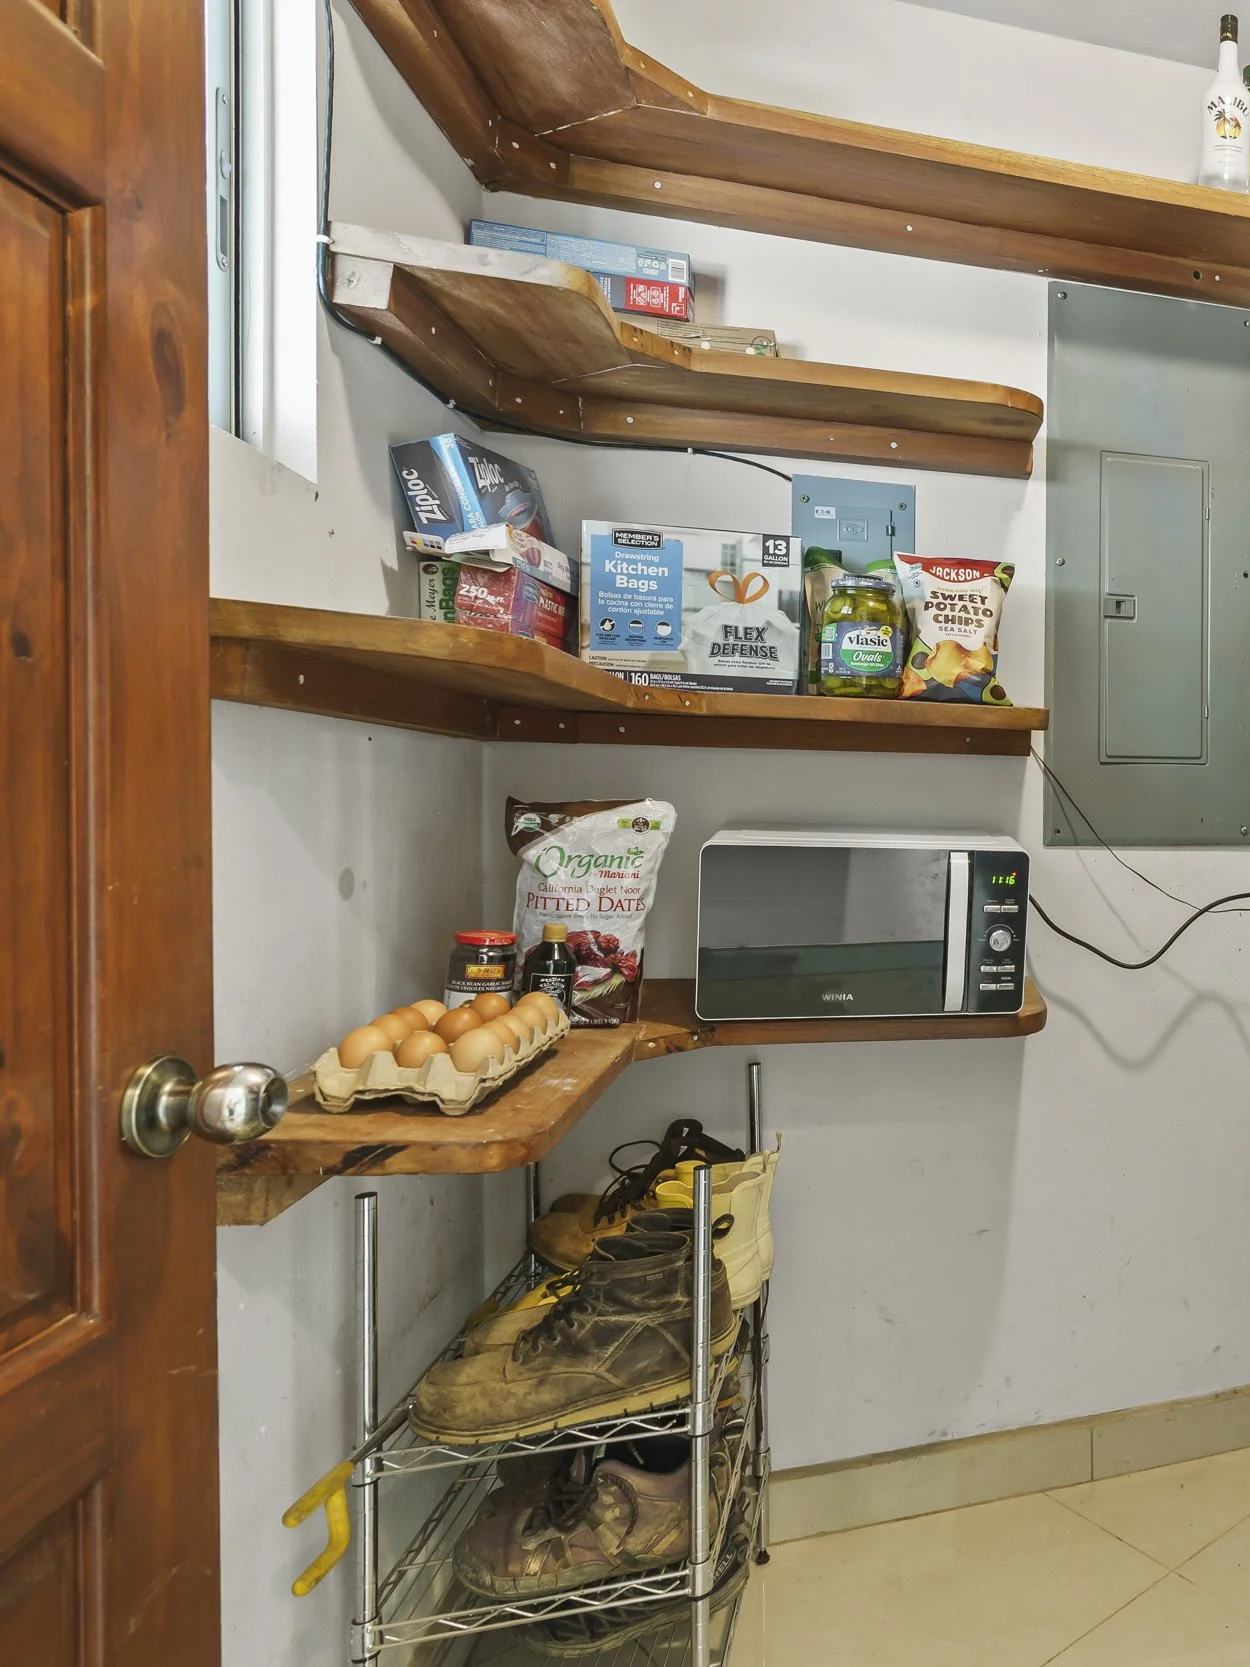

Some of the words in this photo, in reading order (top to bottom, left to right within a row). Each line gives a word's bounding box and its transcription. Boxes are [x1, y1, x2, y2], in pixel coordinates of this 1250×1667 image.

[468, 457, 505, 493] Ziploc
[402, 468, 447, 524] Ziploc
[615, 532, 660, 541] MEMBER'S
[617, 538, 658, 547] SELECTION
[765, 539, 787, 555] 13
[615, 551, 660, 562] Drawstring
[605, 560, 669, 577] Kitchen
[930, 567, 980, 581] JACKSON
[615, 575, 658, 592] Bags
[459, 584, 488, 598] 250
[598, 591, 621, 599] Bolsas
[623, 591, 632, 599] de
[634, 592, 657, 601] basura
[930, 591, 988, 605] SWEET
[606, 599, 629, 607] cocina
[924, 601, 993, 618] POTATO
[633, 607, 665, 616] ajustable
[933, 613, 985, 628] CHIPS
[722, 624, 768, 643] FLEX
[848, 634, 888, 647] vlasic
[709, 642, 779, 661] DEFENSE
[853, 651, 883, 662] Ovals
[631, 672, 649, 685] 160
[535, 846, 645, 878] Organic
[599, 870, 640, 879] Mariani
[538, 883, 582, 894] California
[586, 885, 617, 896] Deglet
[620, 885, 641, 895] Noor
[526, 892, 590, 912] PITTED
[598, 896, 646, 912] DATES
[821, 993, 853, 1001] WINIA
